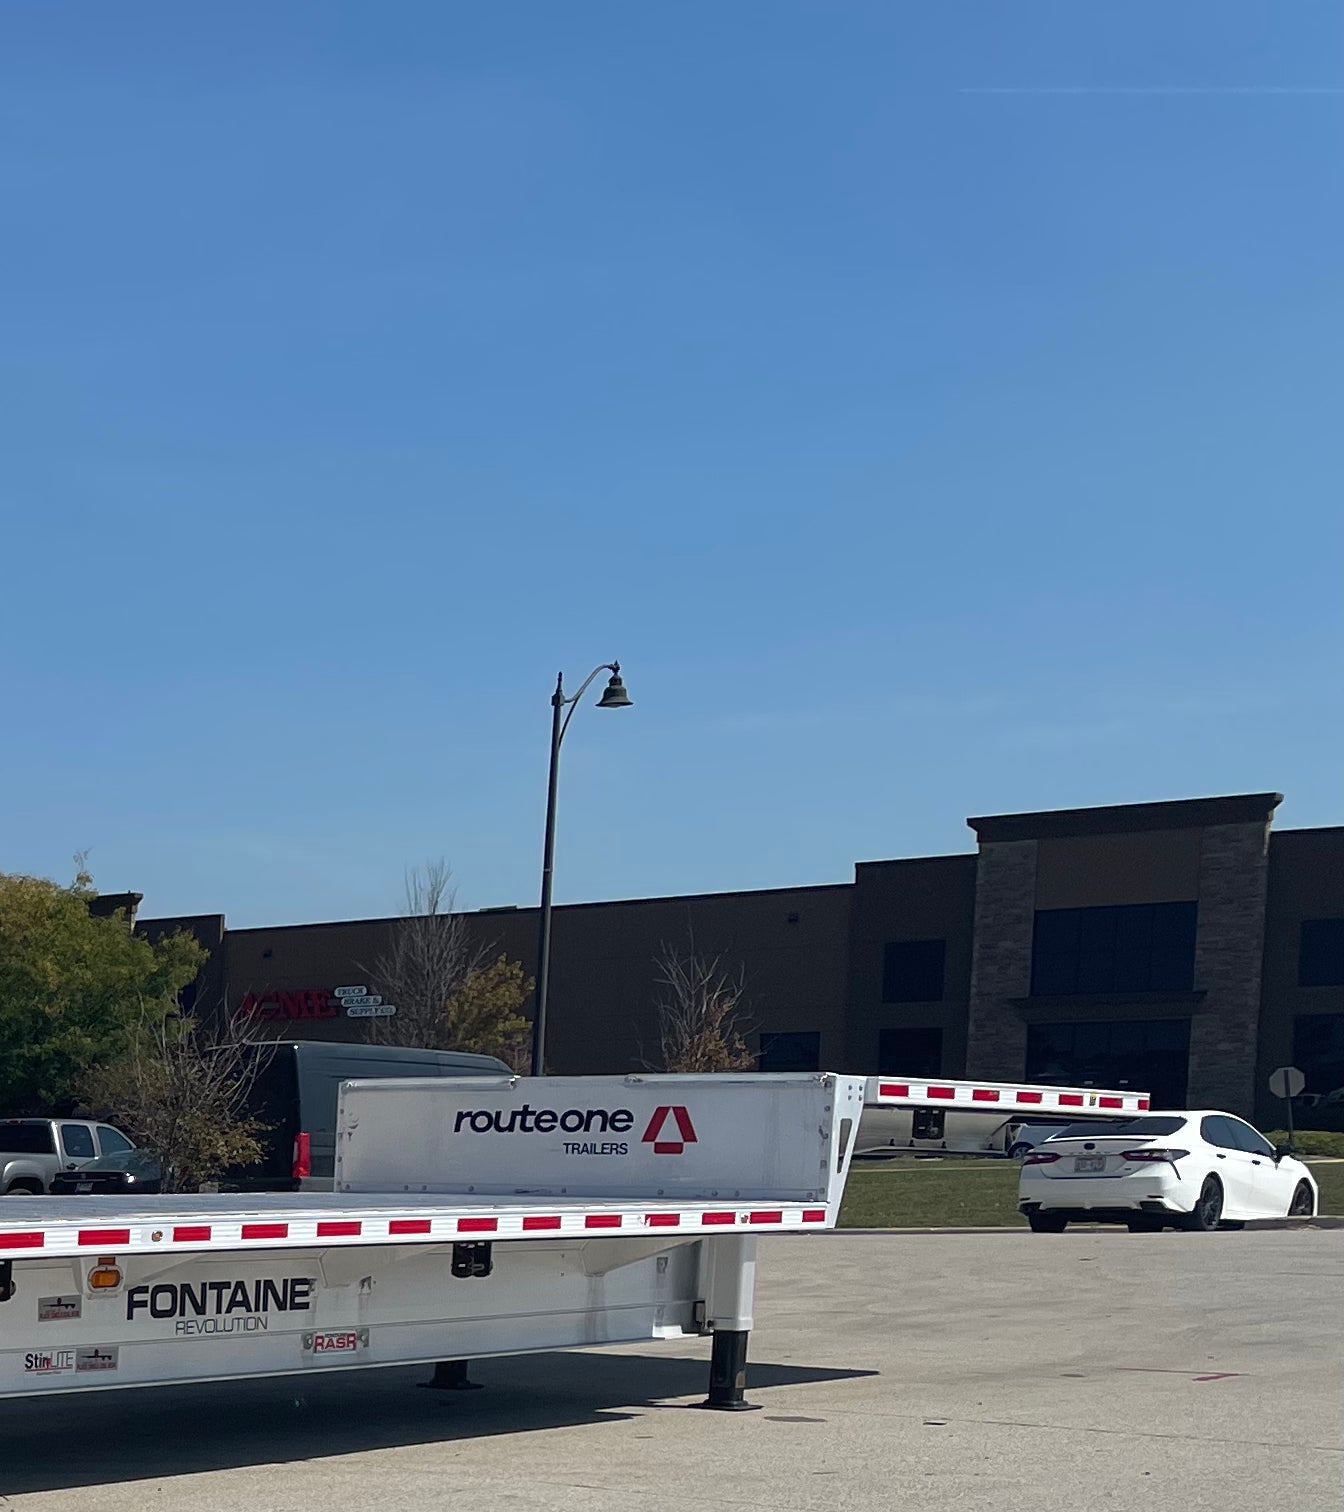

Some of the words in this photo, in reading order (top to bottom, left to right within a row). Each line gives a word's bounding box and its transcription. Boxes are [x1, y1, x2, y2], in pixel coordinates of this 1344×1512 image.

[454, 1104, 633, 1133] routeone
[563, 1142, 627, 1155] TRAILERS
[127, 1278, 311, 1320] FONTAINE
[176, 1316, 268, 1335] REVOLUTION
[314, 1333, 357, 1353] RASR
